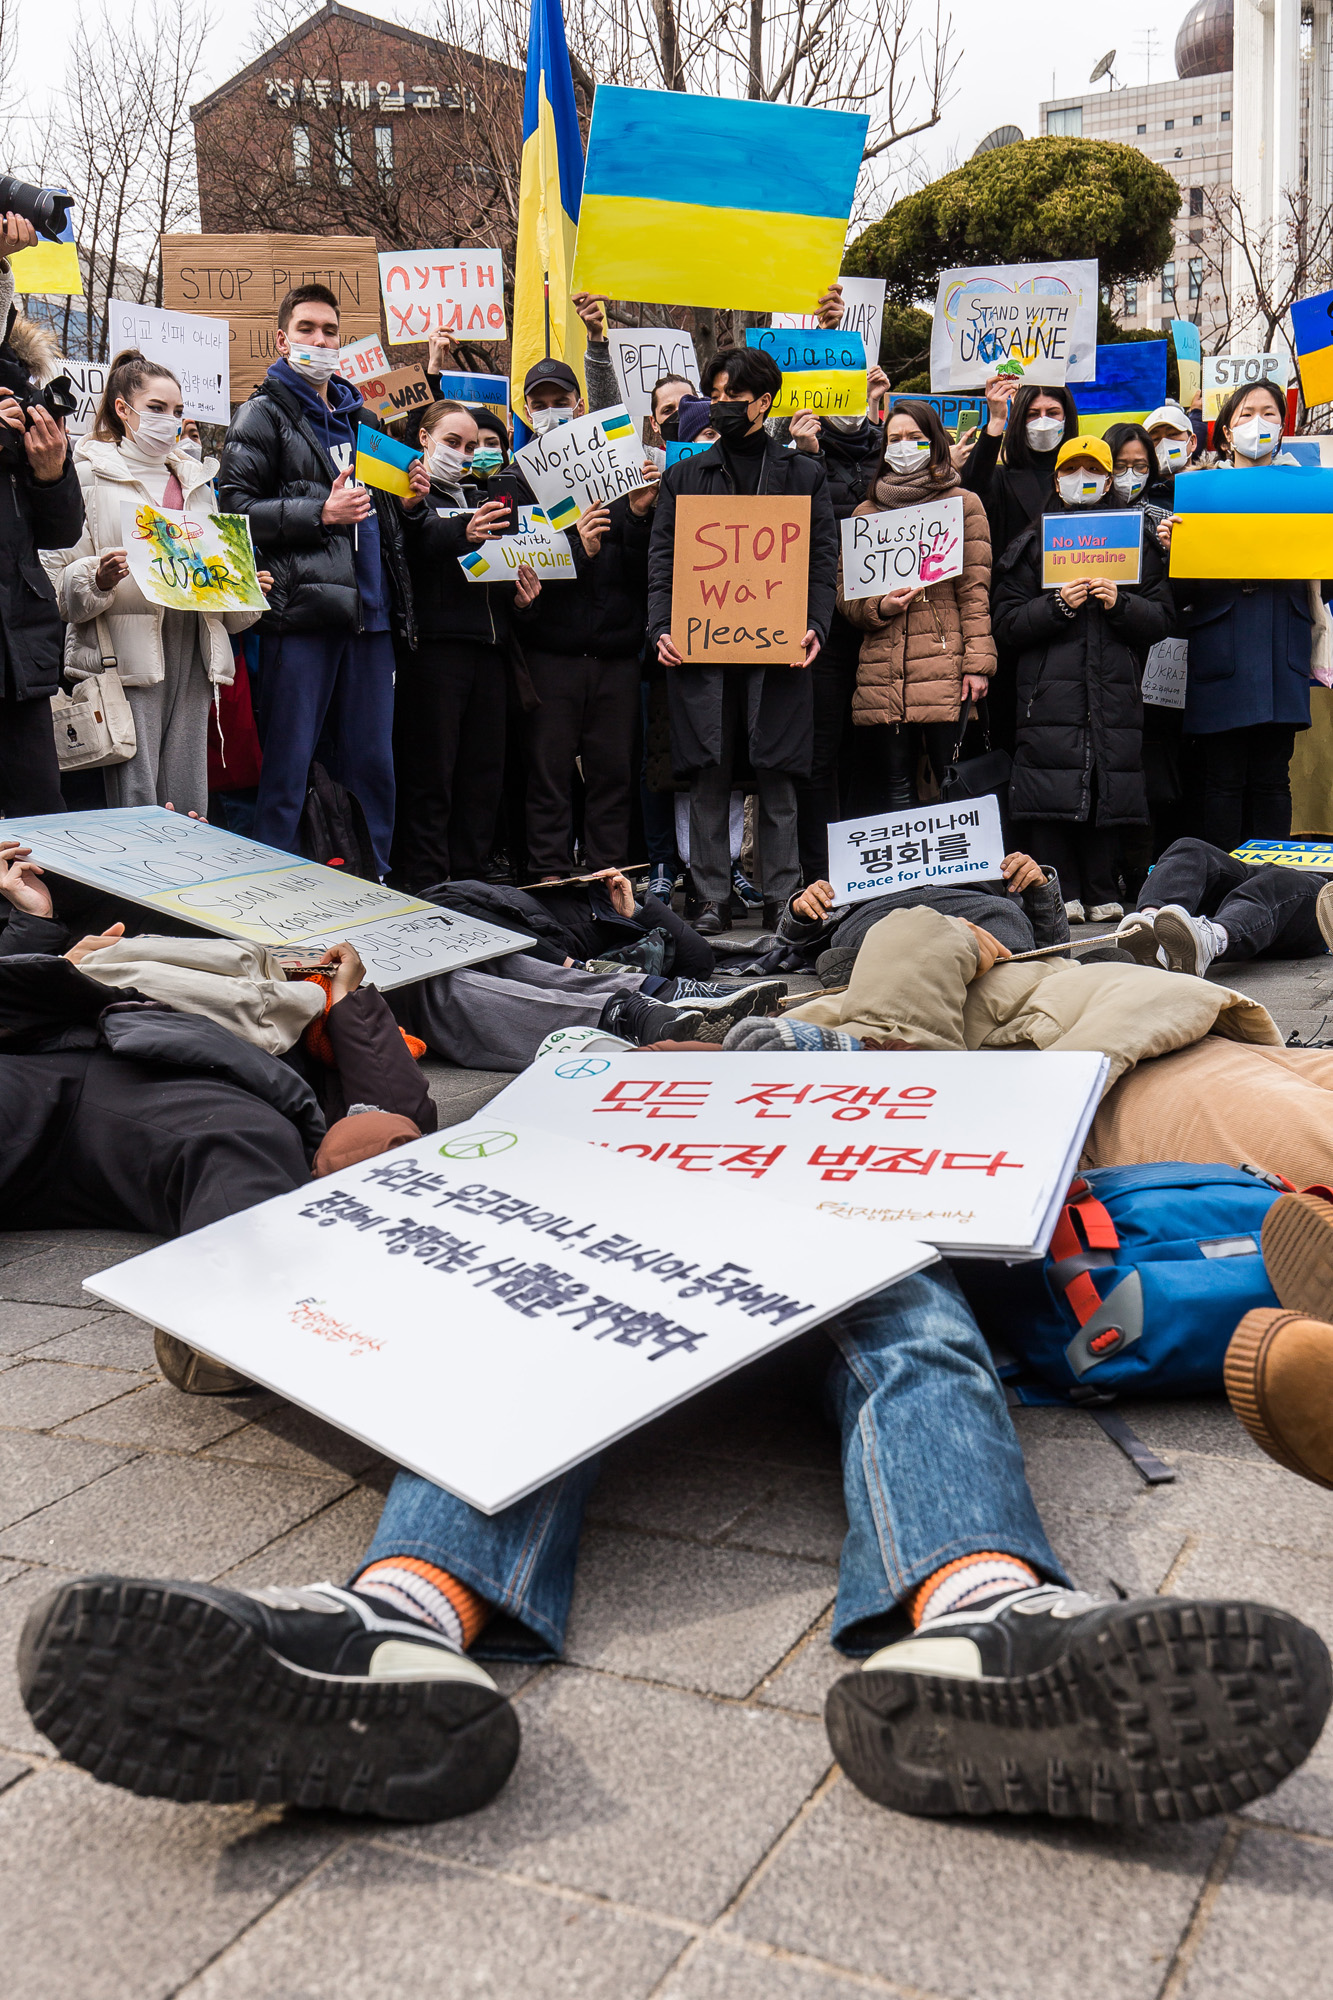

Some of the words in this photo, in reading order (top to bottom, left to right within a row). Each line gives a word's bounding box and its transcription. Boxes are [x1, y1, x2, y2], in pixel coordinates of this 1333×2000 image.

[264, 77, 476, 114] 정동제일교회
[180, 267, 253, 302] STOP
[966, 298, 1019, 321] STAND
[1026, 306, 1069, 322] WITH
[122, 316, 152, 344] 외교
[161, 322, 185, 344] 실패
[193, 330, 222, 349] 아니라
[355, 346, 385, 375] OFF
[1214, 358, 1278, 384] STOP
[63, 366, 104, 394] NO
[360, 380, 386, 401] NO
[389, 381, 429, 409] WAR
[448, 389, 463, 399] NO
[468, 390, 480, 399] TO
[482, 392, 502, 401] WAR
[692, 521, 800, 572] STOP
[853, 516, 949, 550] Russia
[1052, 536, 1073, 549] No
[1078, 535, 1107, 547] War
[859, 543, 932, 584] STOP
[1052, 552, 1066, 565] in
[1070, 551, 1126, 564] Ukraine
[687, 617, 788, 656] Please
[10, 830, 127, 860] NO
[846, 809, 980, 847] 우크라이나에
[99, 860, 204, 890] NO
[176, 846, 284, 871] Putin
[859, 832, 971, 874] 평화를
[847, 874, 894, 892] Peace
[898, 870, 921, 882] for
[925, 860, 989, 877] Ukraine
[178, 885, 284, 919] Stand
[592, 1080, 713, 1119] 모든
[734, 1082, 937, 1121] 전쟁은
[590, 1141, 787, 1179] 도적
[807, 1144, 1024, 1181] 범죄다
[361, 1158, 448, 1197] 우리는
[579, 1233, 700, 1283] 러시아
[298, 1190, 390, 1232] 전쟁에
[378, 1217, 487, 1274] 저항하는
[467, 1257, 590, 1318] 사람들을
[557, 1294, 708, 1361] 지지한다
